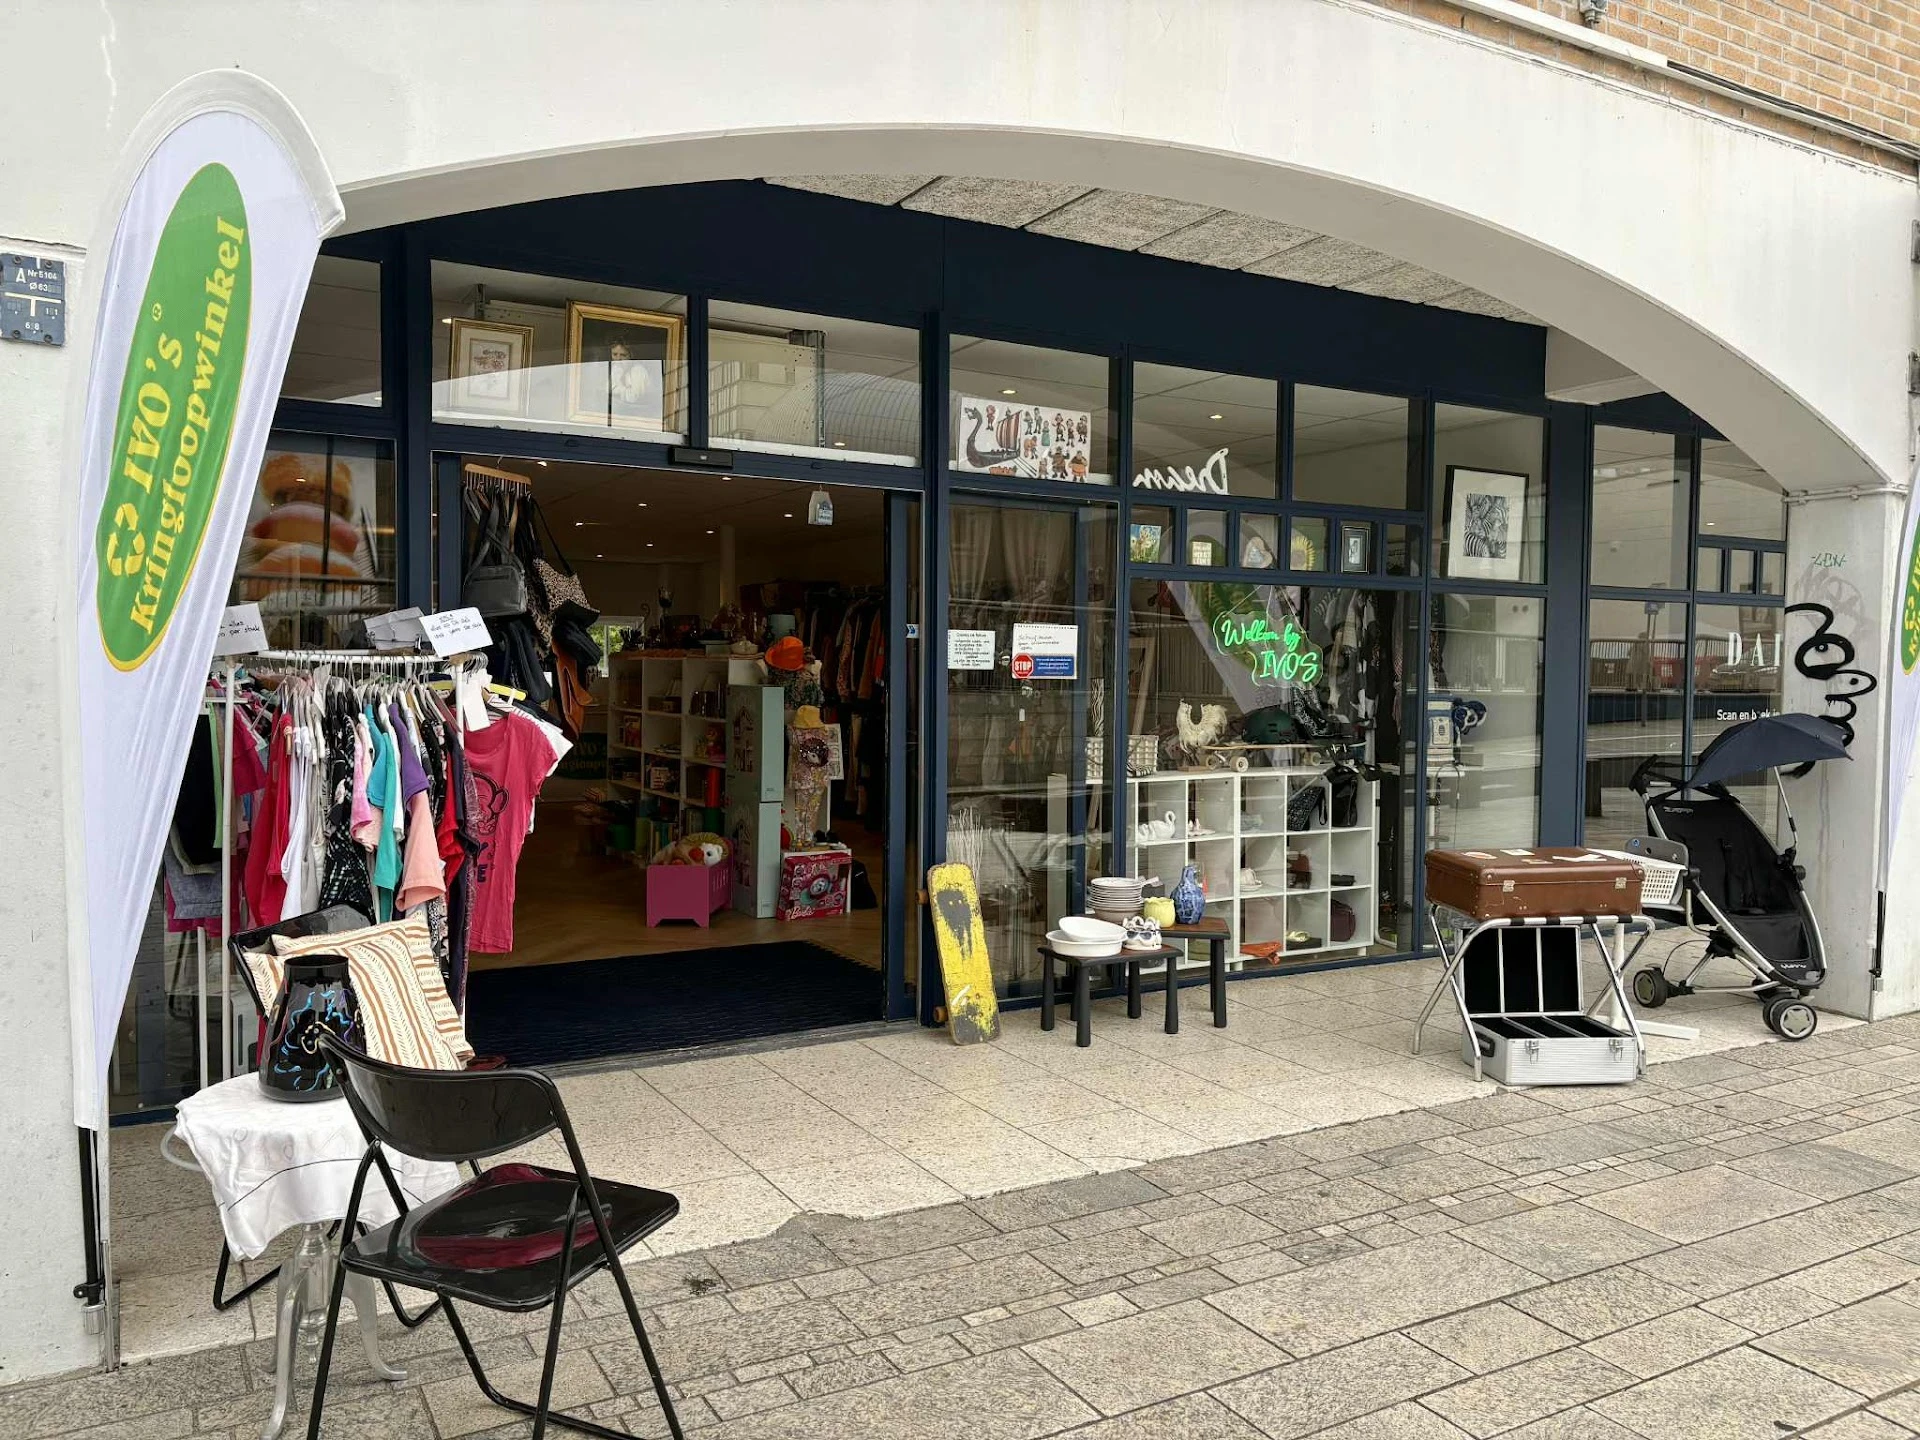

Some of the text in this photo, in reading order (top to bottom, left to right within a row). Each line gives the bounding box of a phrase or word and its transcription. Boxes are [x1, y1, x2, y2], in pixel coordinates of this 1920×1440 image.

[16, 268, 26, 283] A
[123, 332, 183, 494] IVO's
[130, 216, 245, 635] Kringloopwinkel
[1014, 660, 1032, 671] STOP
[1259, 649, 1319, 682] IVOS
[1716, 708, 1738, 721] Scan
[1739, 711, 1750, 720] en
